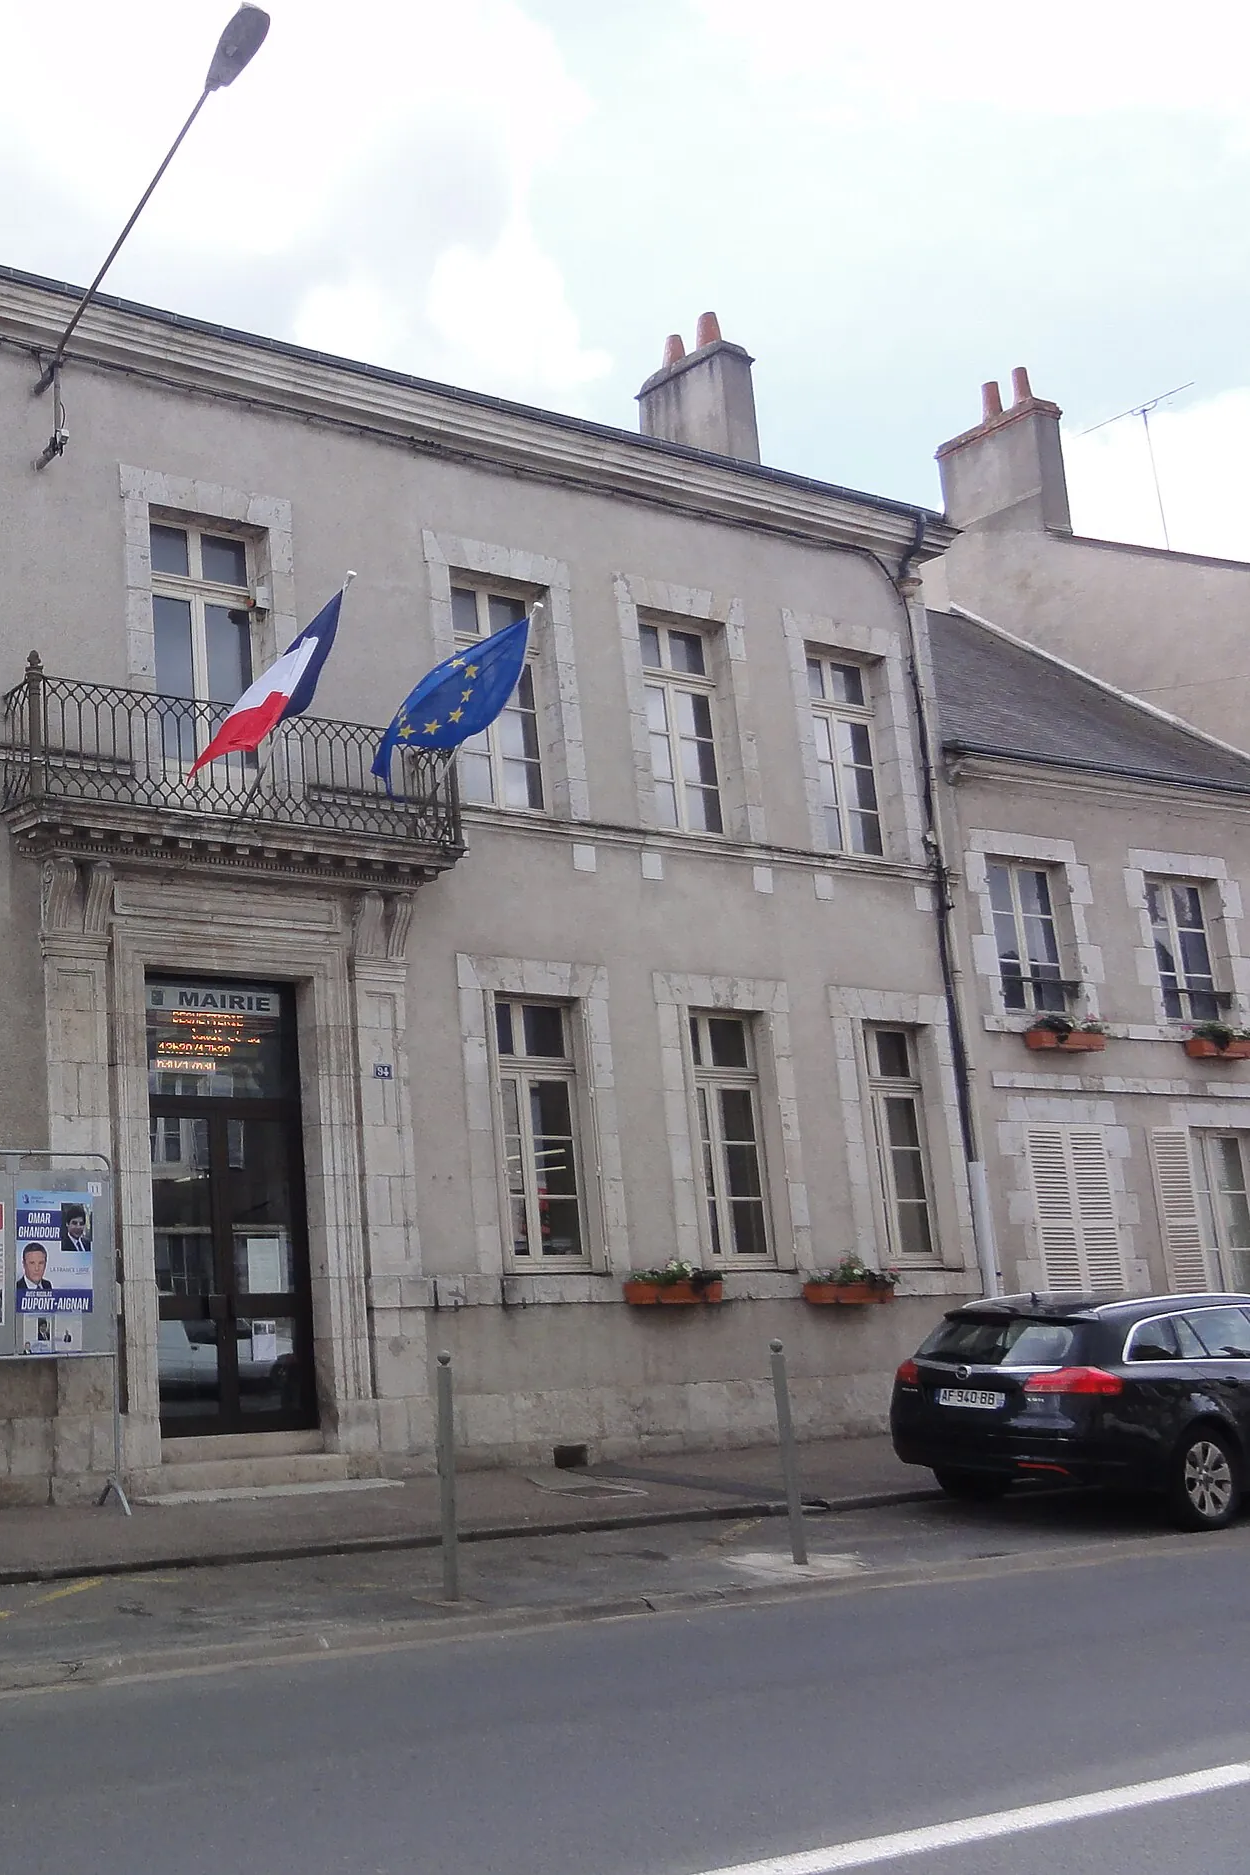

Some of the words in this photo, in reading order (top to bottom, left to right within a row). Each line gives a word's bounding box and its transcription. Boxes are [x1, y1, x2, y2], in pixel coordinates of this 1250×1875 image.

[178, 991, 271, 1011] MAIRIE
[28, 1212, 51, 1224] OMAR
[18, 1226, 60, 1238] GHANDOUR
[21, 1297, 89, 1310] DUPONT-AIGNAN
